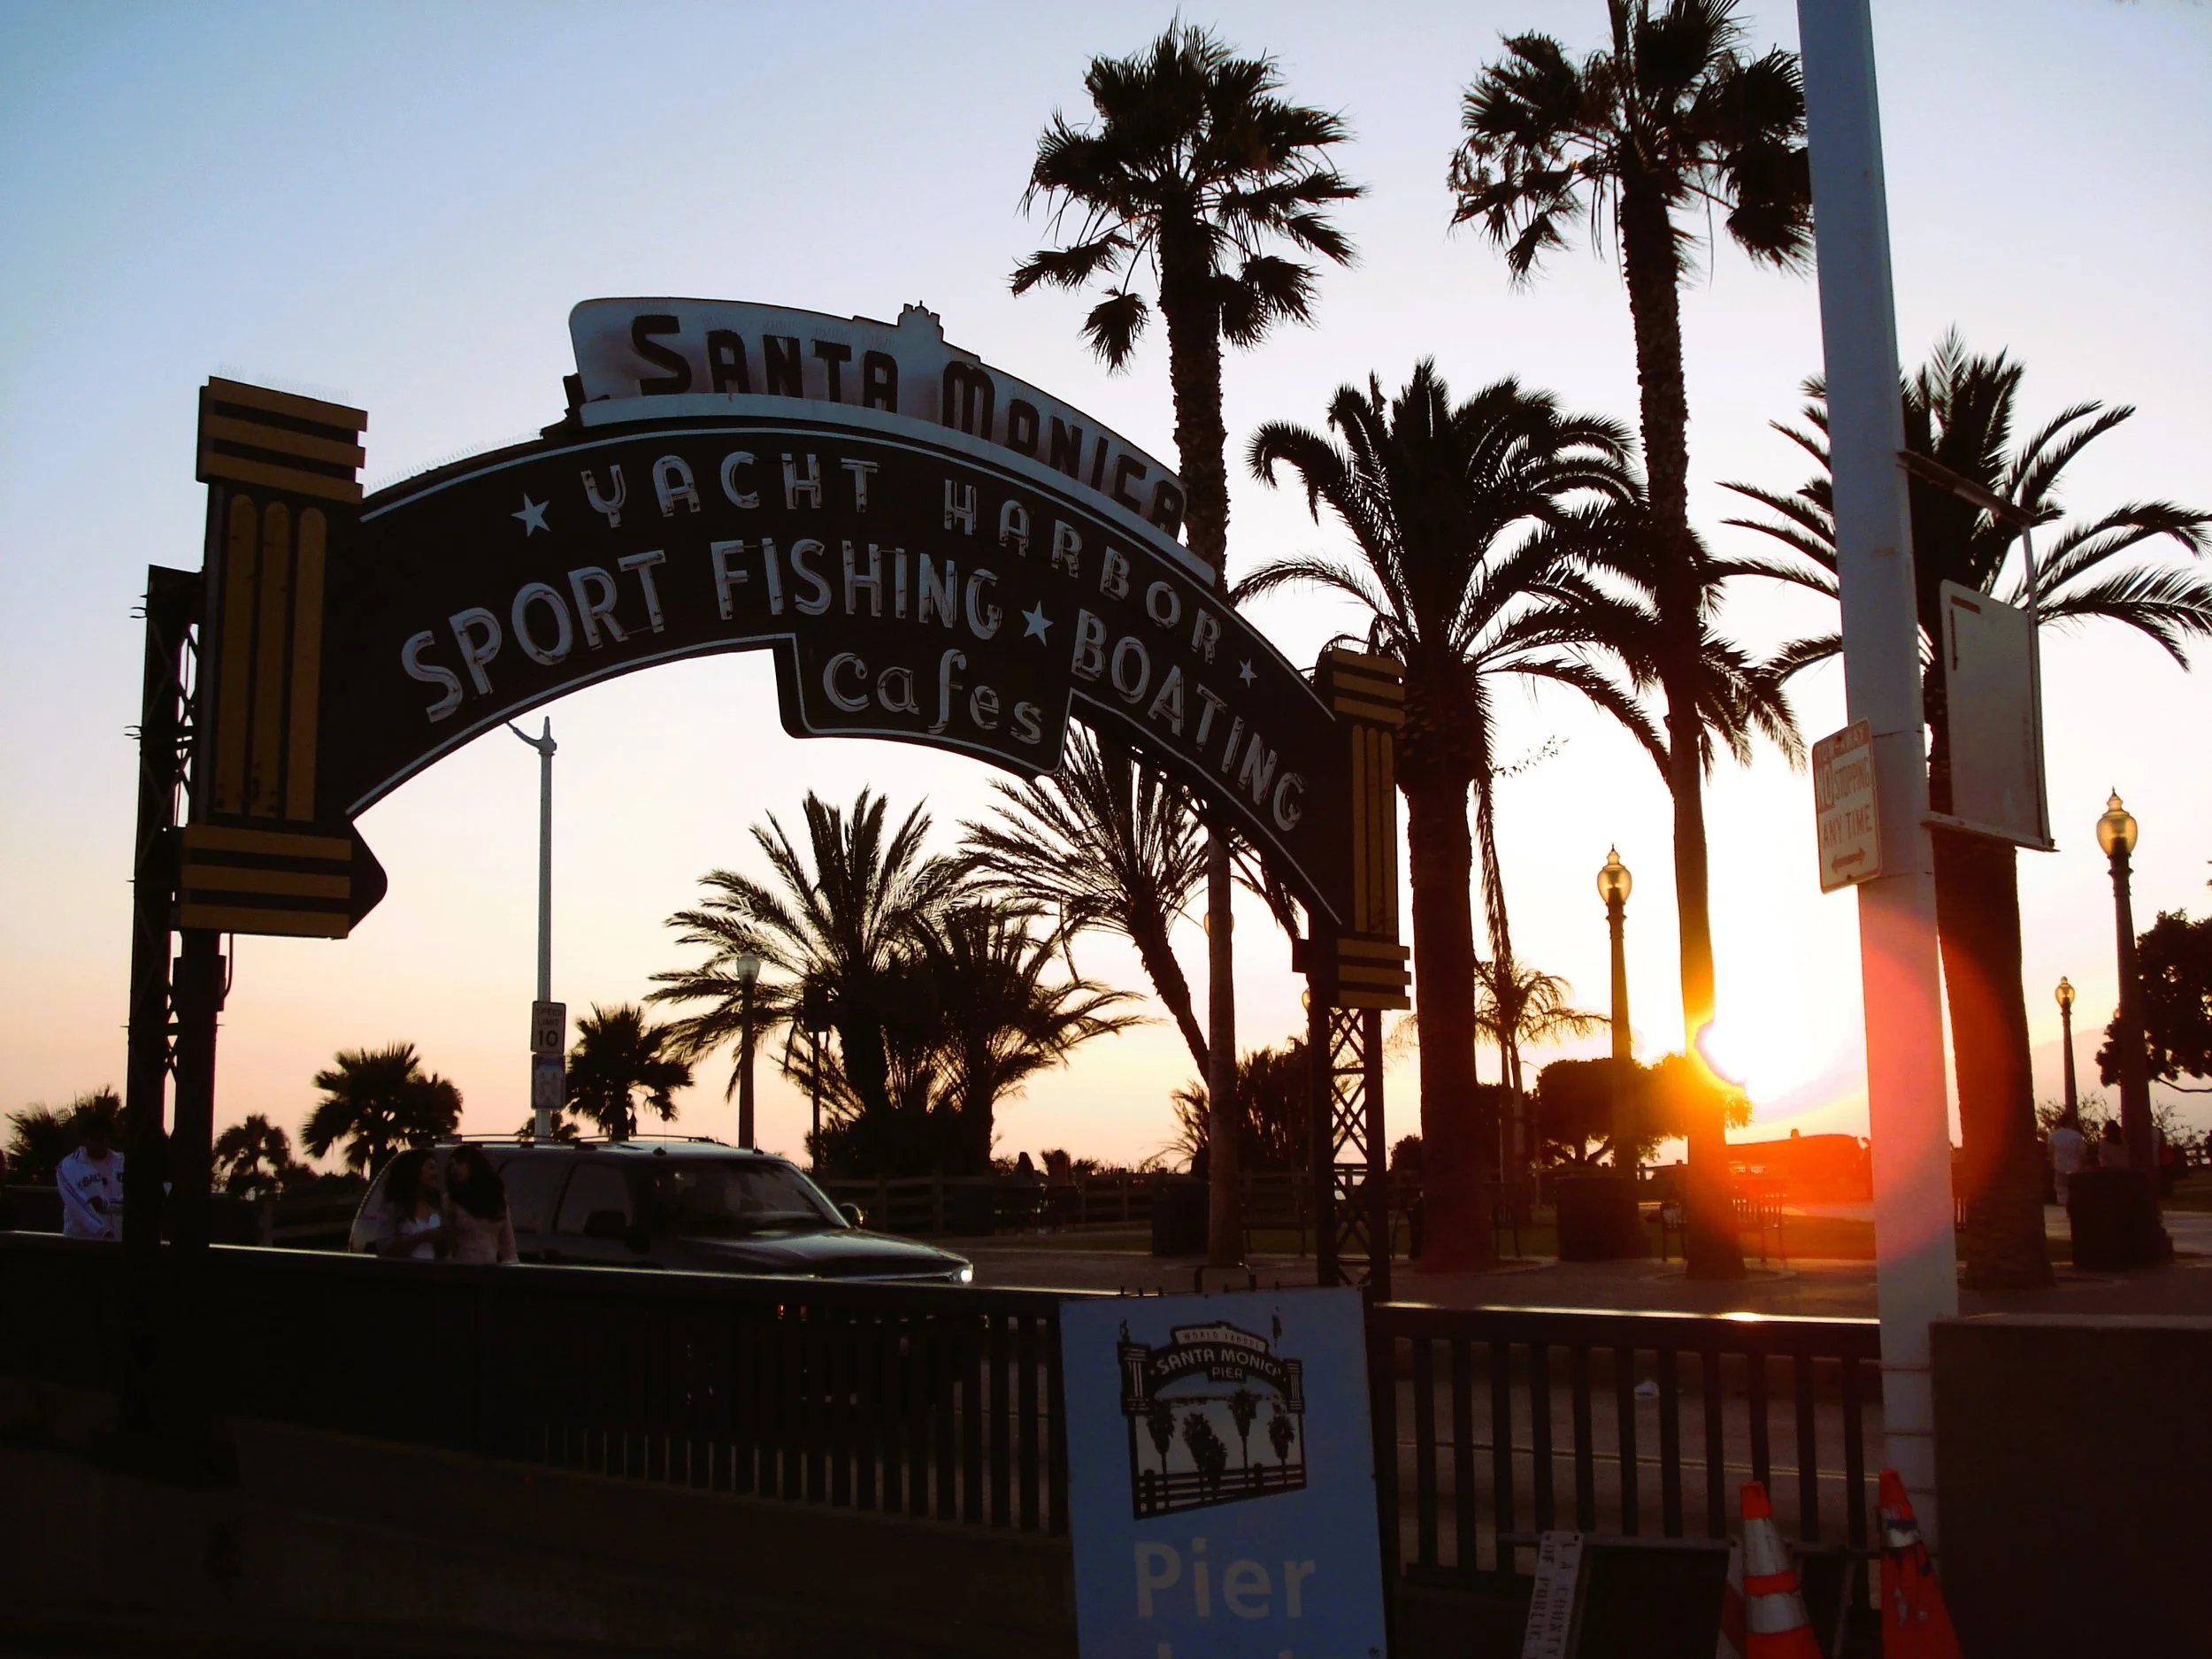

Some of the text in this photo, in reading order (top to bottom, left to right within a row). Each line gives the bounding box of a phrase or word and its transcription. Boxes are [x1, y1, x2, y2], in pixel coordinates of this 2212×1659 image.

[632, 314, 1187, 542] SANTA MONICA
[580, 451, 1221, 665] YACHT HARBOR
[401, 537, 1307, 833] SPORT FISHING BOATING
[822, 648, 1043, 745] Cafes
[1824, 804, 1873, 849] ANY TIME
[539, 1029, 558, 1047] 10
[1155, 1348, 1282, 1378] SANTA MONICA
[1211, 1366, 1243, 1379] PIER
[1133, 1537, 1317, 1619] Pier
